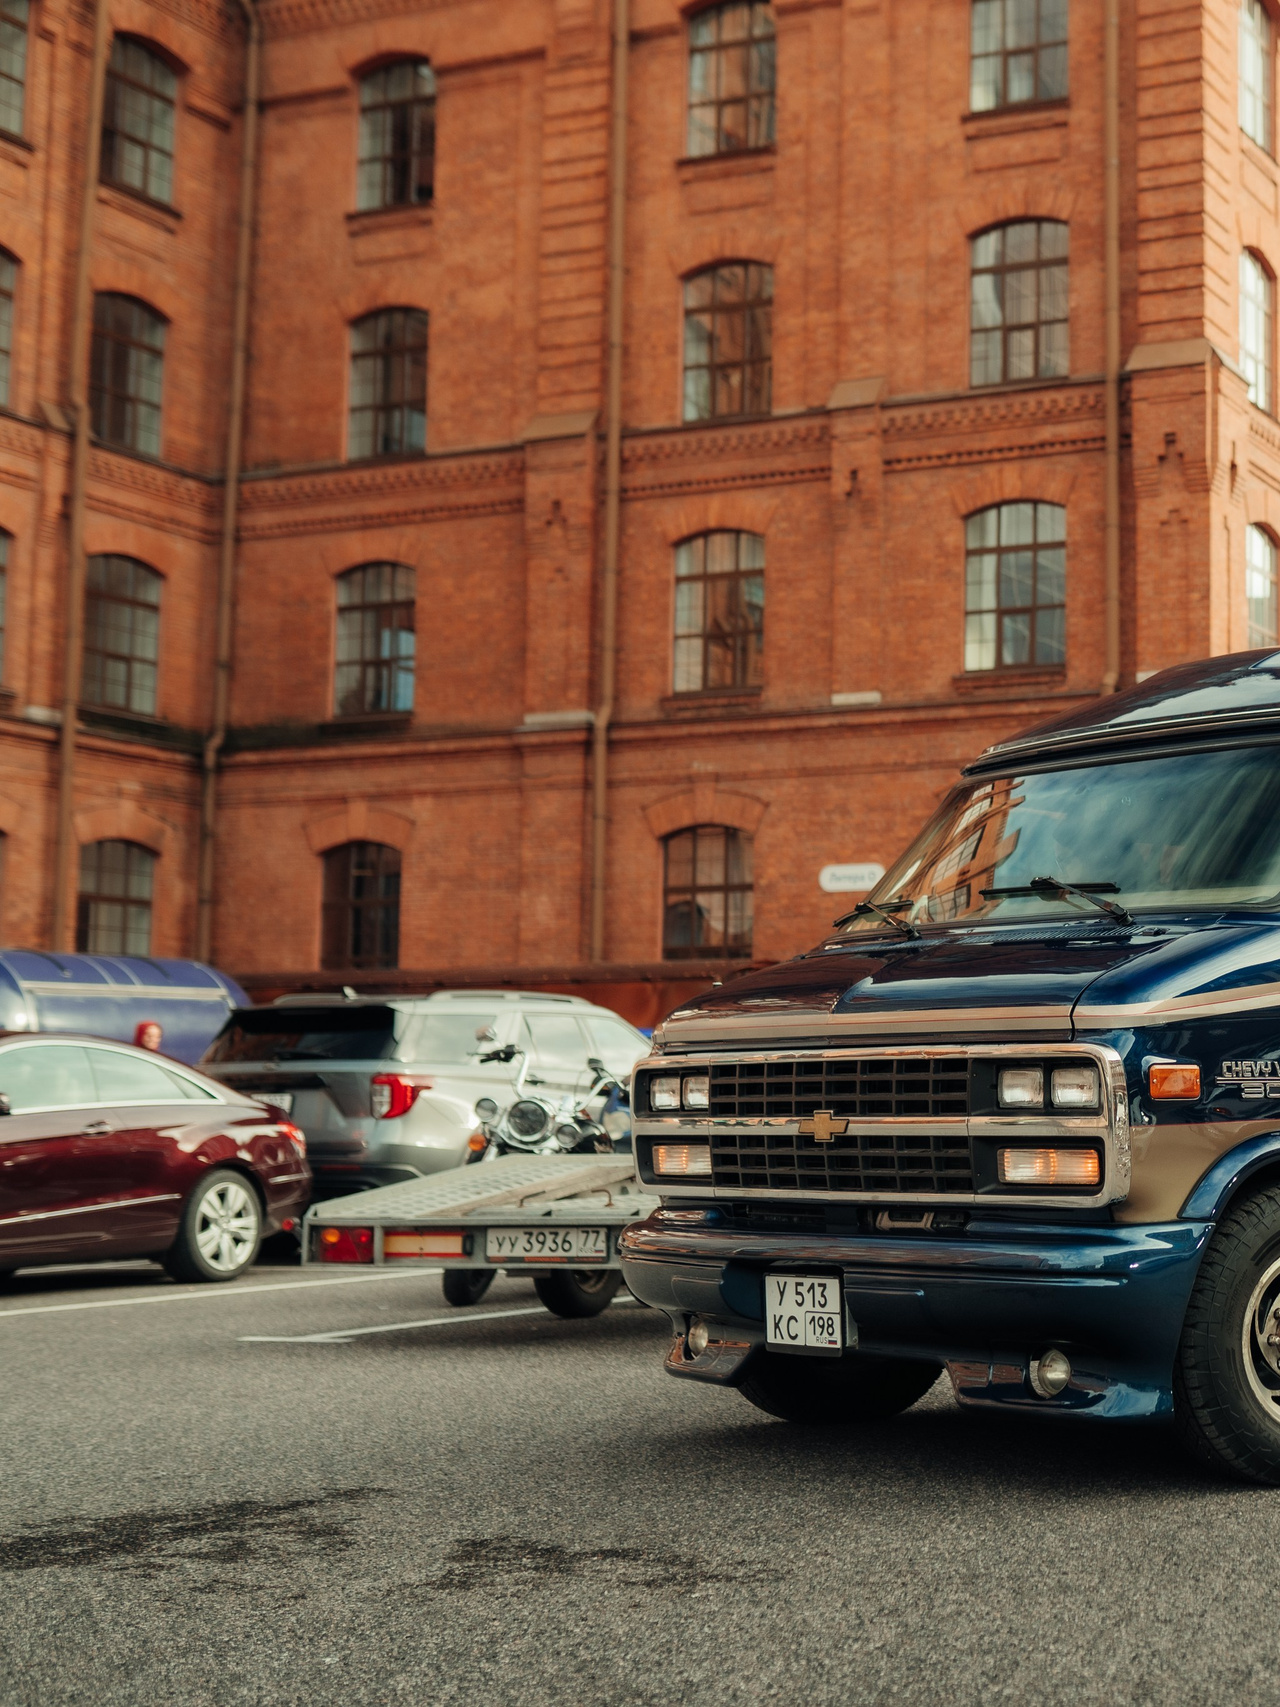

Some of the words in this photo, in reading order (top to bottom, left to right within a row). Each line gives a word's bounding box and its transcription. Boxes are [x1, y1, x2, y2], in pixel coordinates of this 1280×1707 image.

[1222, 1061, 1272, 1077] CHEVY
[581, 1230, 601, 1247] 77
[776, 1280, 788, 1306] У
[794, 1281, 828, 1308] 513
[773, 1313, 799, 1341] КС
[808, 1315, 835, 1337] 198
[815, 1336, 828, 1345] RUS
